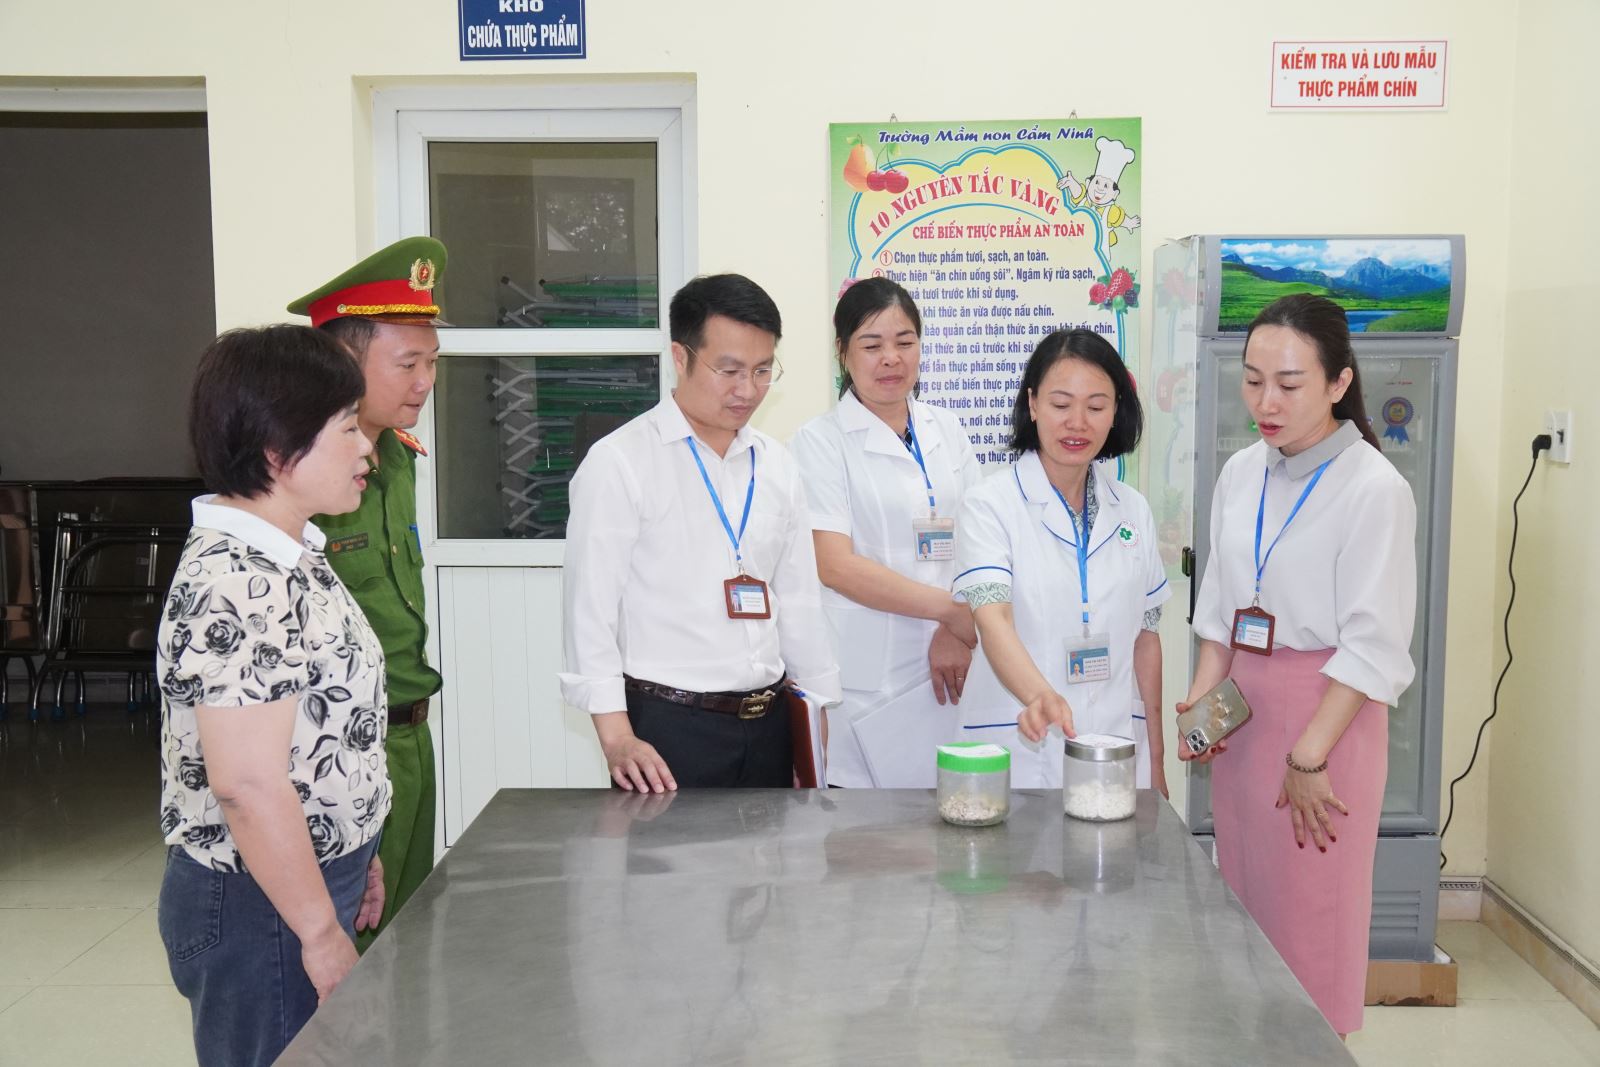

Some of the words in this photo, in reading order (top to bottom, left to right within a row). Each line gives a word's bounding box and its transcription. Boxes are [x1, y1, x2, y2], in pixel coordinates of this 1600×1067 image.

[498, 0, 544, 12] KHO
[467, 19, 502, 48] CHỨA
[504, 22, 537, 52] THỰC
[540, 14, 578, 46] PHẨM
[1281, 46, 1316, 69] KIỂM
[1321, 53, 1347, 69] TRA
[1351, 48, 1369, 69] VÀ
[1373, 51, 1400, 69] LƯU
[1404, 45, 1437, 69] MẪU
[1298, 79, 1333, 101] THỰC
[1337, 74, 1379, 97] PHẨM
[1383, 76, 1417, 97] CHÍN
[879, 130, 930, 145] Trường
[935, 126, 978, 142] Mầm
[983, 131, 1011, 140] non
[1016, 124, 1051, 140] Cẩm
[1057, 127, 1093, 139] Ninh
[869, 211, 890, 237] 10
[890, 174, 963, 219] NGUYÊN
[968, 166, 1004, 194] TẮC
[1010, 178, 1060, 216] VÀNG
[912, 220, 935, 239] CHẾ
[937, 220, 963, 239] BIẾN
[967, 223, 997, 242] THỰC
[1000, 216, 1031, 238] PHẨM
[1034, 224, 1050, 237] AN
[1053, 220, 1085, 237] TOÀN
[894, 251, 916, 265] Chọn
[918, 251, 937, 265] thực
[940, 247, 963, 265] phẩm
[966, 250, 985, 264] tươi,
[988, 250, 1011, 264] sạch,
[1013, 251, 1024, 262] an
[1027, 249, 1049, 261] toàn.
[909, 269, 927, 284] hiện
[970, 267, 991, 283] uống
[1016, 267, 1040, 282] Ngâm
[1055, 266, 1070, 279] rửa
[1072, 267, 1096, 281] sạch,
[922, 287, 939, 299] tươi
[941, 287, 964, 299] trước
[966, 286, 980, 298] khi
[982, 285, 993, 299] sử
[995, 287, 1019, 301] dụng.
[922, 306, 936, 318] khi
[938, 305, 957, 318] thức
[960, 306, 971, 317] ăn
[973, 305, 988, 317] vừa
[991, 305, 1012, 319] được
[1014, 303, 1030, 316] nấu
[1033, 303, 1054, 316] chín.
[924, 324, 940, 336] bảo
[942, 323, 964, 338] quản
[966, 320, 982, 335] cẩn
[985, 323, 1004, 337] thận
[1007, 323, 1025, 335] thức
[1028, 323, 1039, 334] ăn
[1042, 325, 1057, 334] sau
[935, 342, 954, 354] thức
[956, 342, 968, 353] ăn
[969, 342, 980, 353] cũ
[982, 341, 1005, 353] trước
[1008, 341, 1021, 353] khi
[949, 360, 968, 374] thực
[970, 357, 994, 374] phẩm
[996, 358, 1016, 373] sống
[931, 381, 941, 393] cụ
[944, 377, 960, 390] chế
[962, 377, 980, 390] biến
[983, 378, 1002, 392] thực
[1005, 376, 1021, 392] phẩ
[949, 396, 972, 408] trước
[974, 396, 987, 408] khi
[989, 394, 1006, 407] chế
[969, 414, 982, 426] nơi
[985, 412, 1001, 426] chế
[988, 450, 1007, 465] thực
